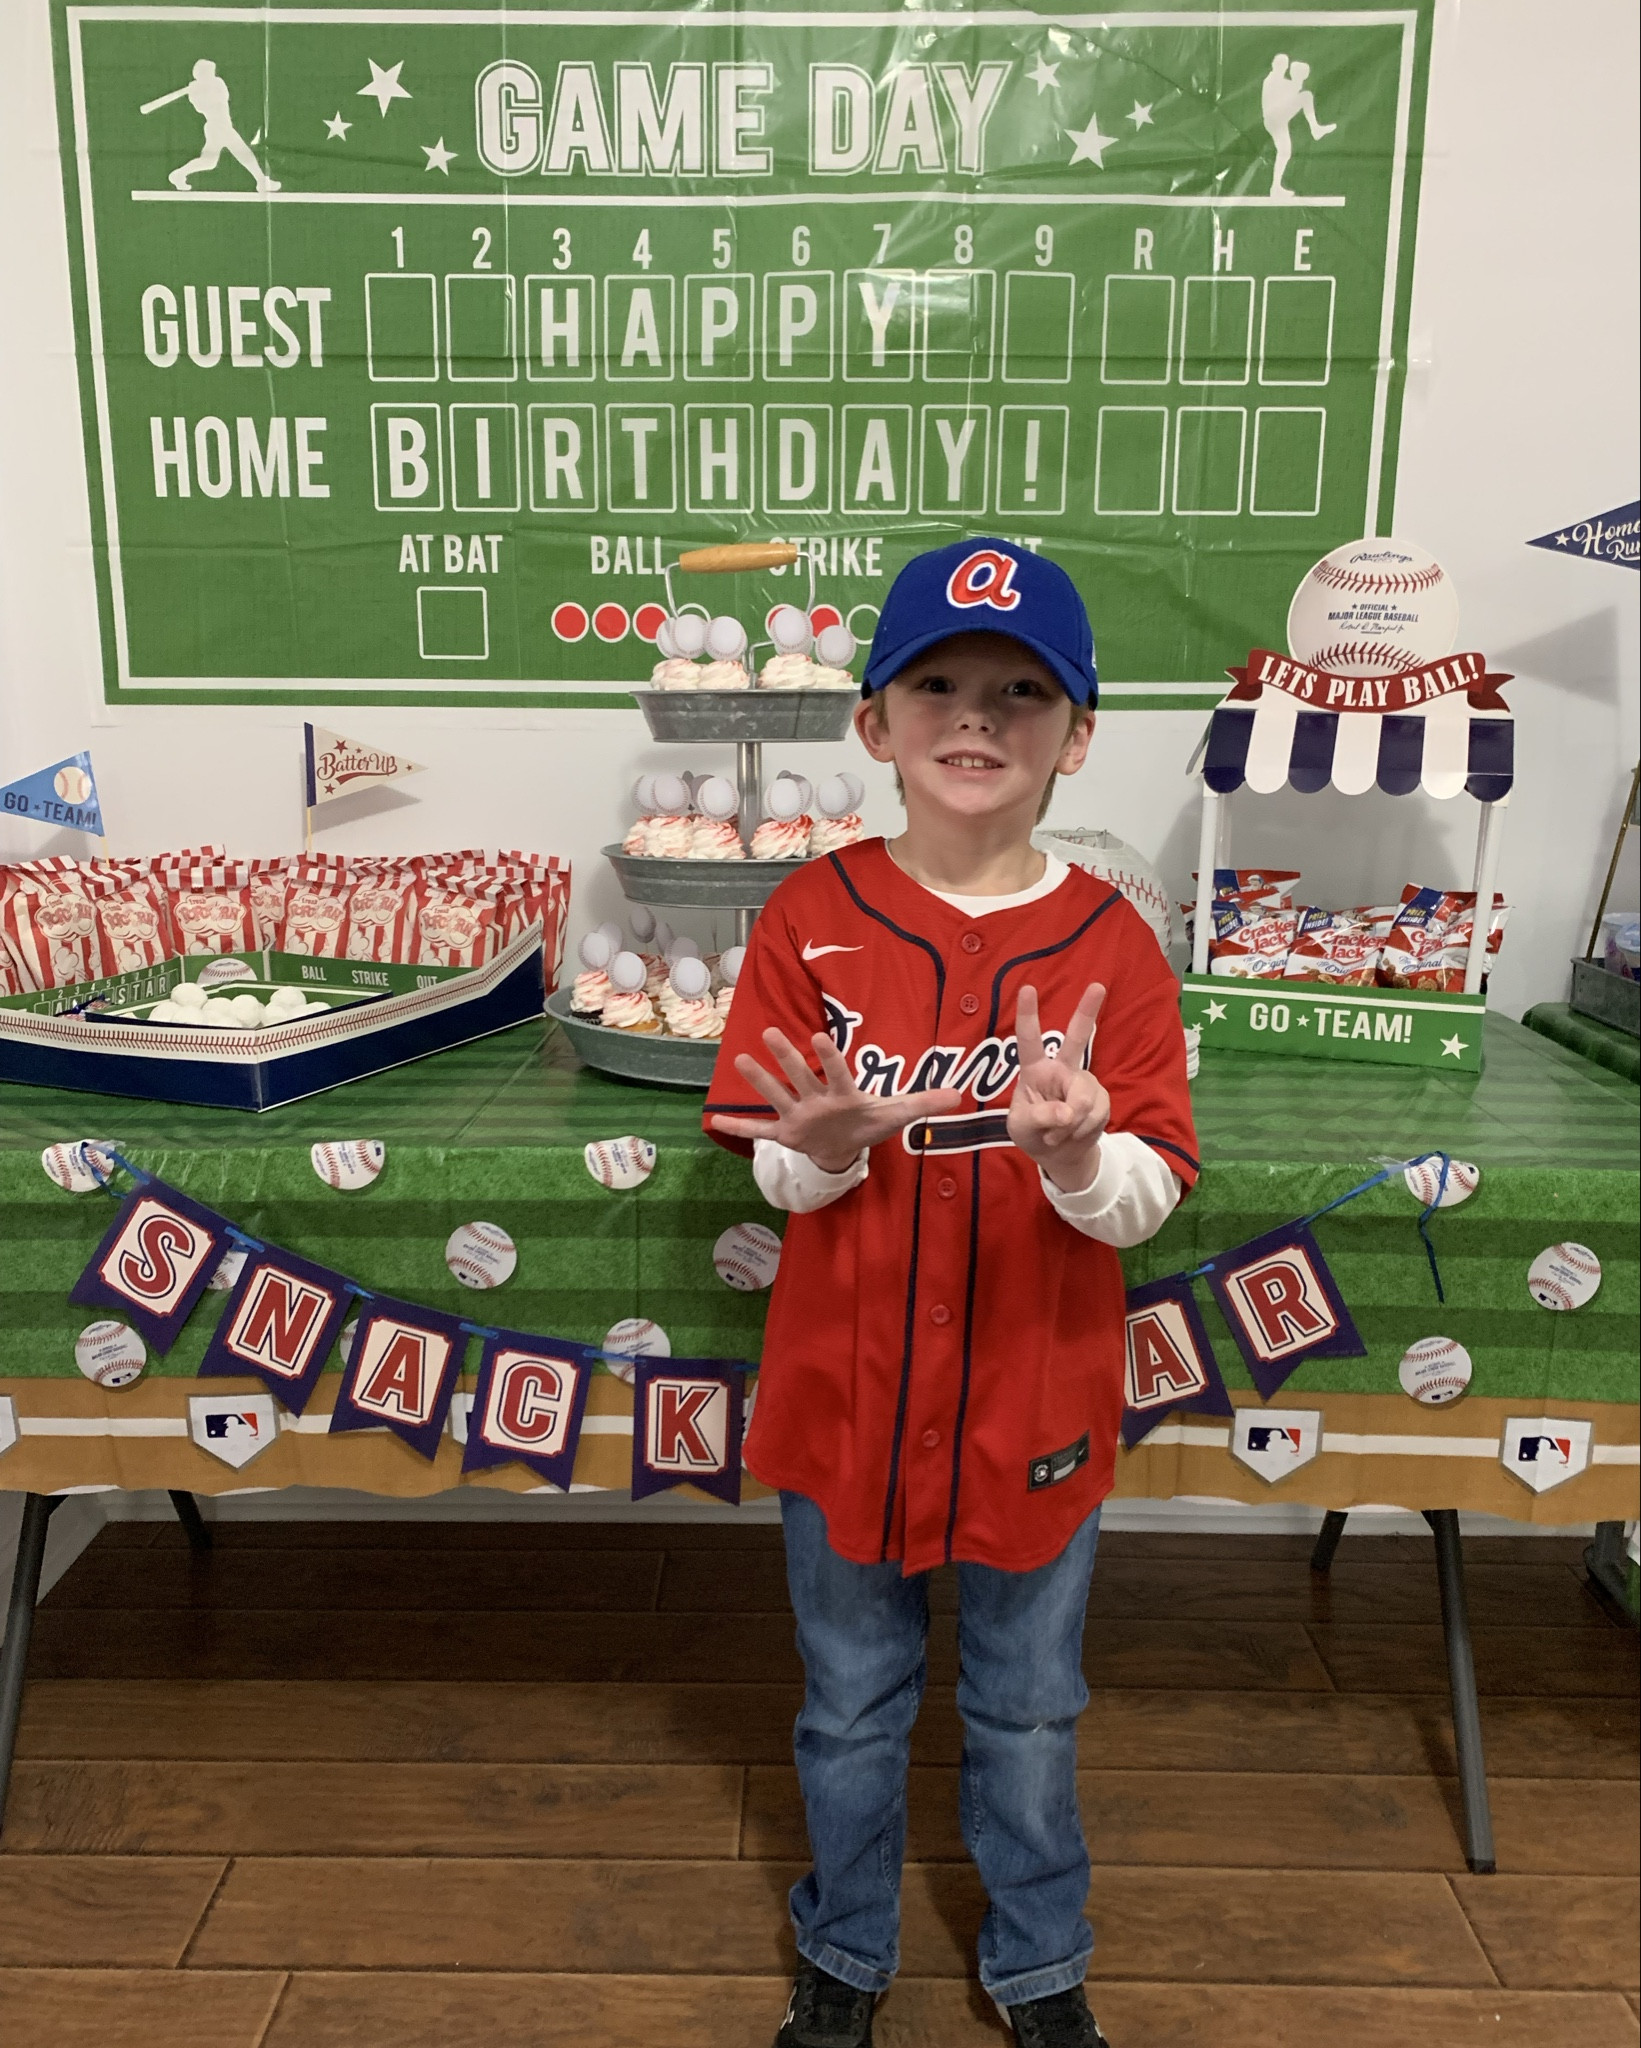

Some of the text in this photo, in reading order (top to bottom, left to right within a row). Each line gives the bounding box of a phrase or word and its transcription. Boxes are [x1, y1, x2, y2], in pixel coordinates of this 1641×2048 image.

[475, 60, 1013, 177] GAME DAY
[391, 225, 1314, 272] 1 2 3 4 5 6 7 8 9 R H E
[141, 283, 902, 369] GUEST HAPPY
[150, 416, 1040, 502] HOME BIRTHDAY!
[399, 535, 503, 574] AT BAT
[591, 536, 666, 575] BALL
[1606, 540, 1640, 560] Ru
[1327, 611, 1419, 623] MAJOR LEAGUE BASEBALL
[1359, 603, 1389, 611] OFFICIAL
[1257, 654, 1480, 708] LETS PLAY BALL!
[3, 791, 97, 827] GO TEAM!
[1304, 918, 1330, 930] INSIDE!
[1249, 932, 1289, 955] Jack
[1323, 945, 1365, 960] Jack
[301, 965, 328, 982] BALL
[351, 970, 390, 988] STRIKE
[416, 974, 438, 989] OUT
[1249, 1002, 1414, 1044] GO TEAM!
[1126, 1259, 1331, 1405] AR
